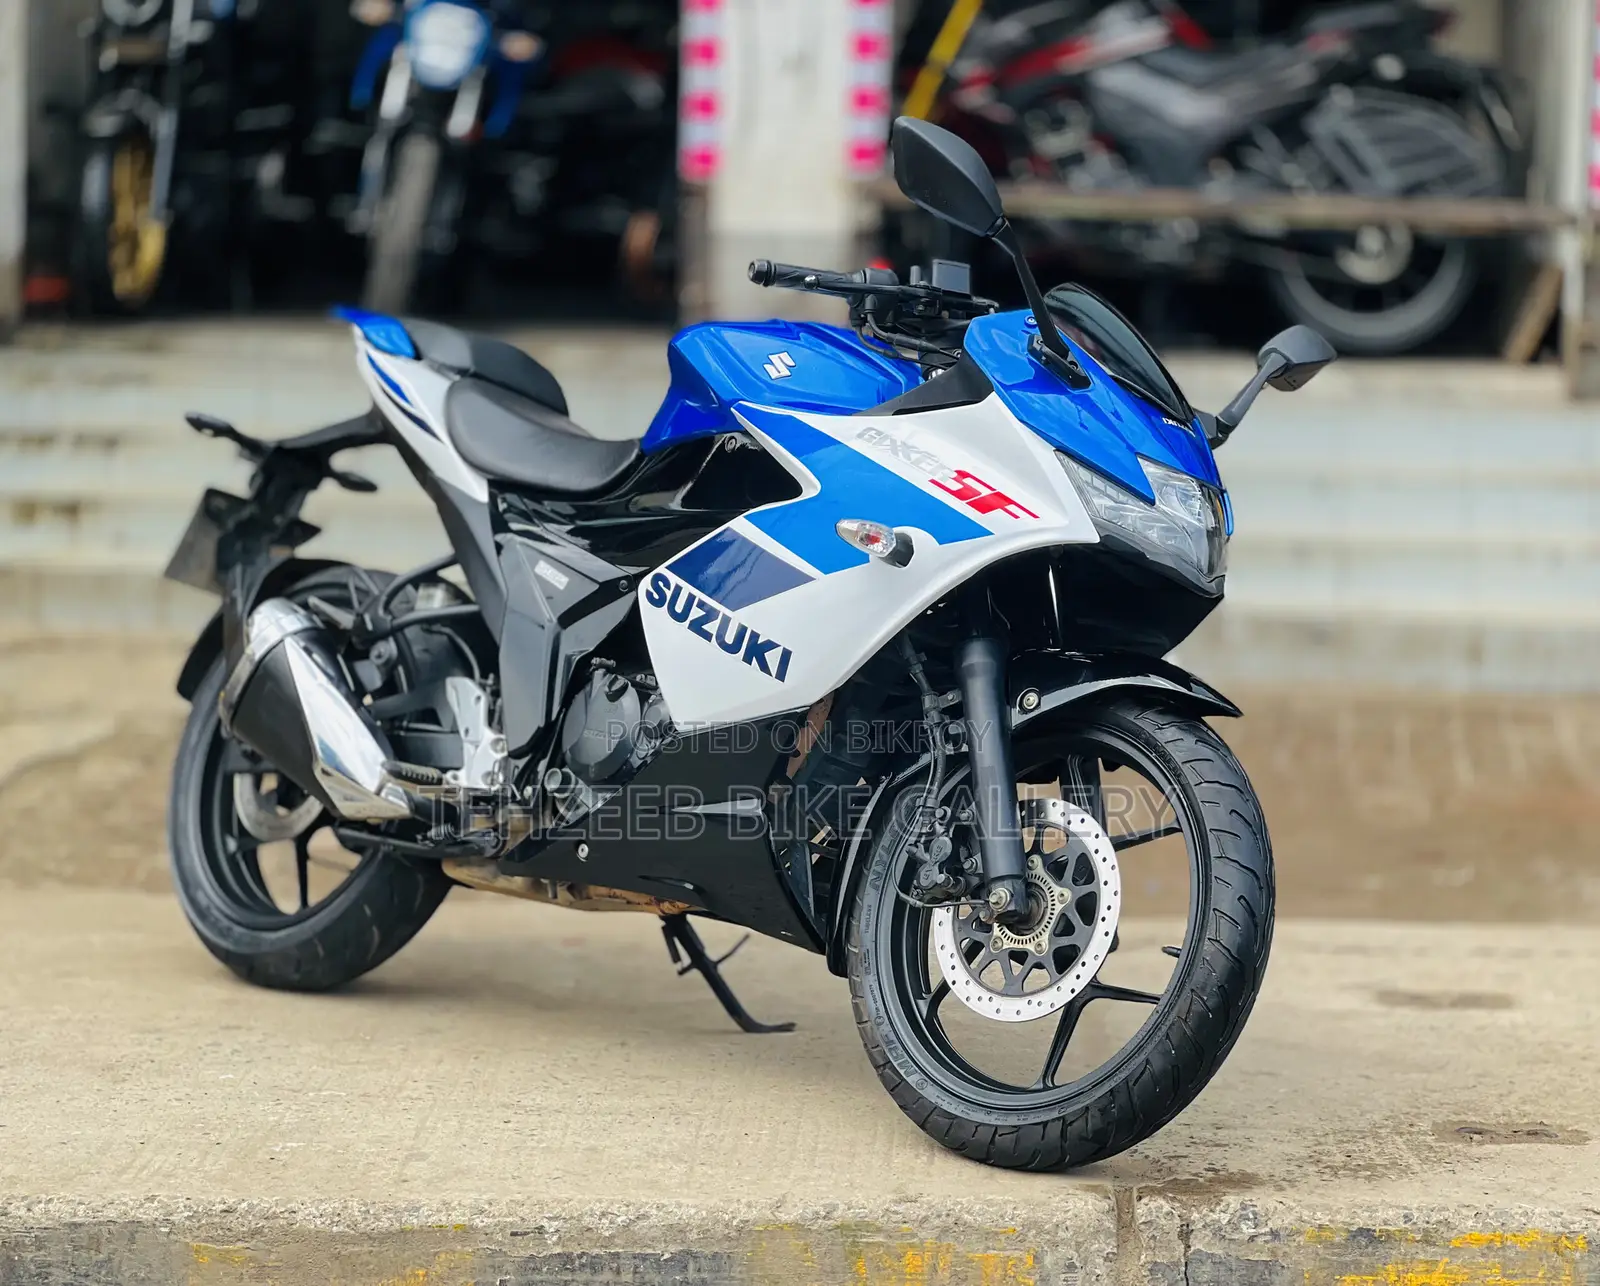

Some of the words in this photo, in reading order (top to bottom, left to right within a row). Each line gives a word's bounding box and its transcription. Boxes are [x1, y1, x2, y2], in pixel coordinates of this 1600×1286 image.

[928, 470, 1040, 519] SF
[645, 572, 793, 683] SUZUKI
[880, 1032, 918, 1078] MRF
